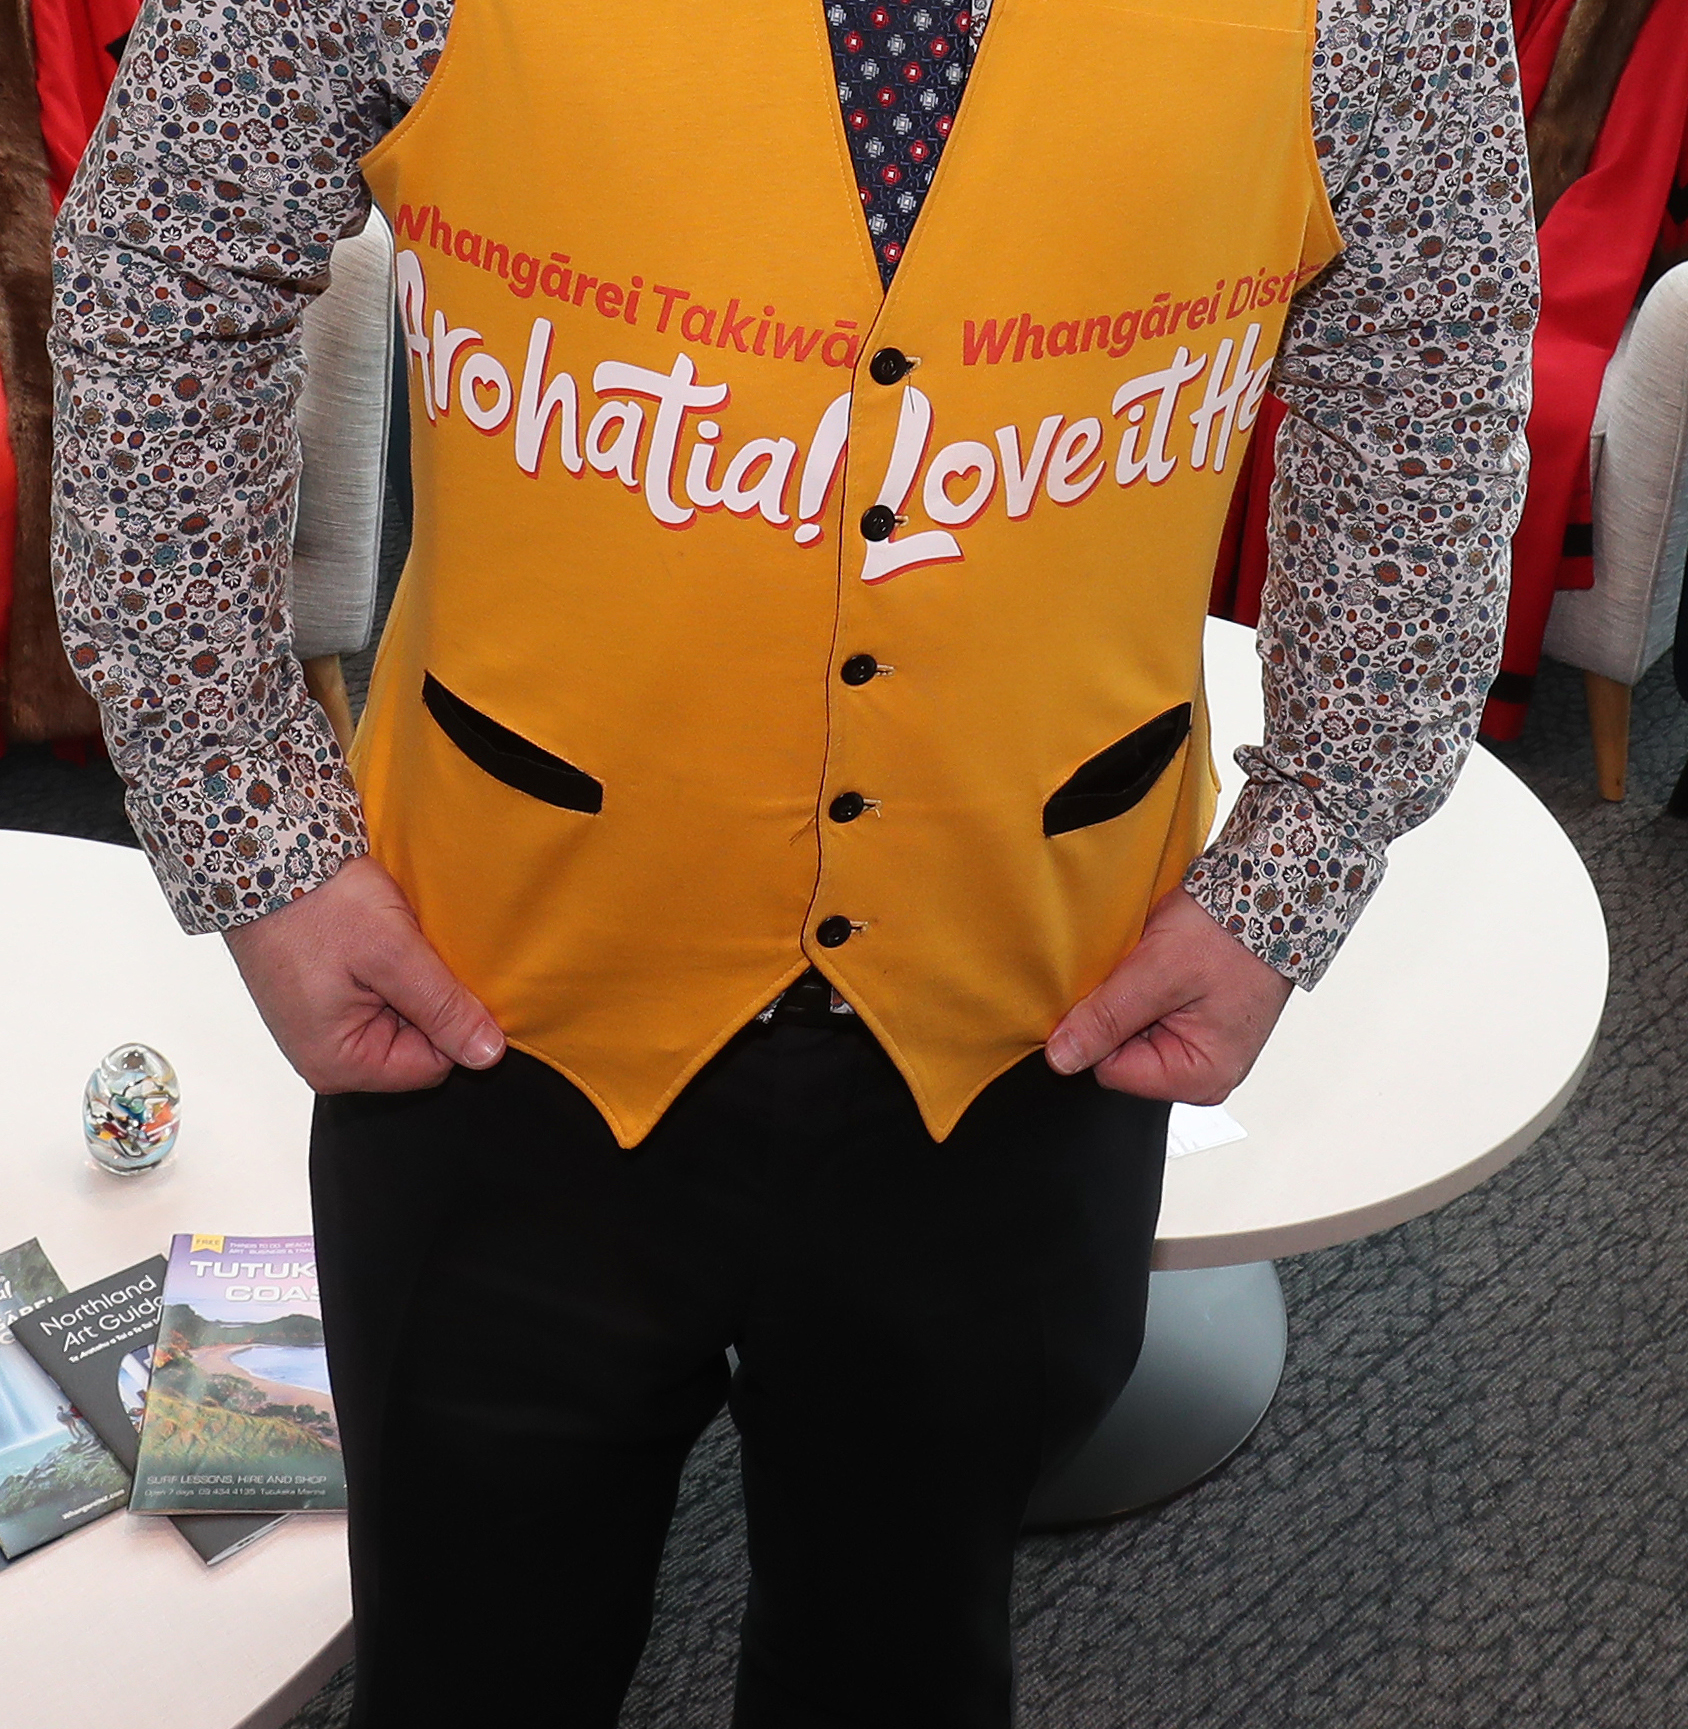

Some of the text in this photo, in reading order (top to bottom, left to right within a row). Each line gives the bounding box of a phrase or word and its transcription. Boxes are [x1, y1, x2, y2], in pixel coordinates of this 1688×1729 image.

[395, 203, 862, 369] Whangārei Takiwā
[962, 262, 1323, 366] Whangārei Dist
[396, 249, 854, 549] Arohatia!
[860, 385, 1107, 585] Love
[1112, 346, 1208, 488] it
[39, 1274, 157, 1336] Northland
[189, 1260, 316, 1279] TUTUK
[63, 1326, 99, 1353] Art
[146, 1475, 178, 1485] SURF
[237, 1475, 263, 1484] HIRE
[266, 1475, 293, 1484] AND
[294, 1475, 327, 1484] SHOP
